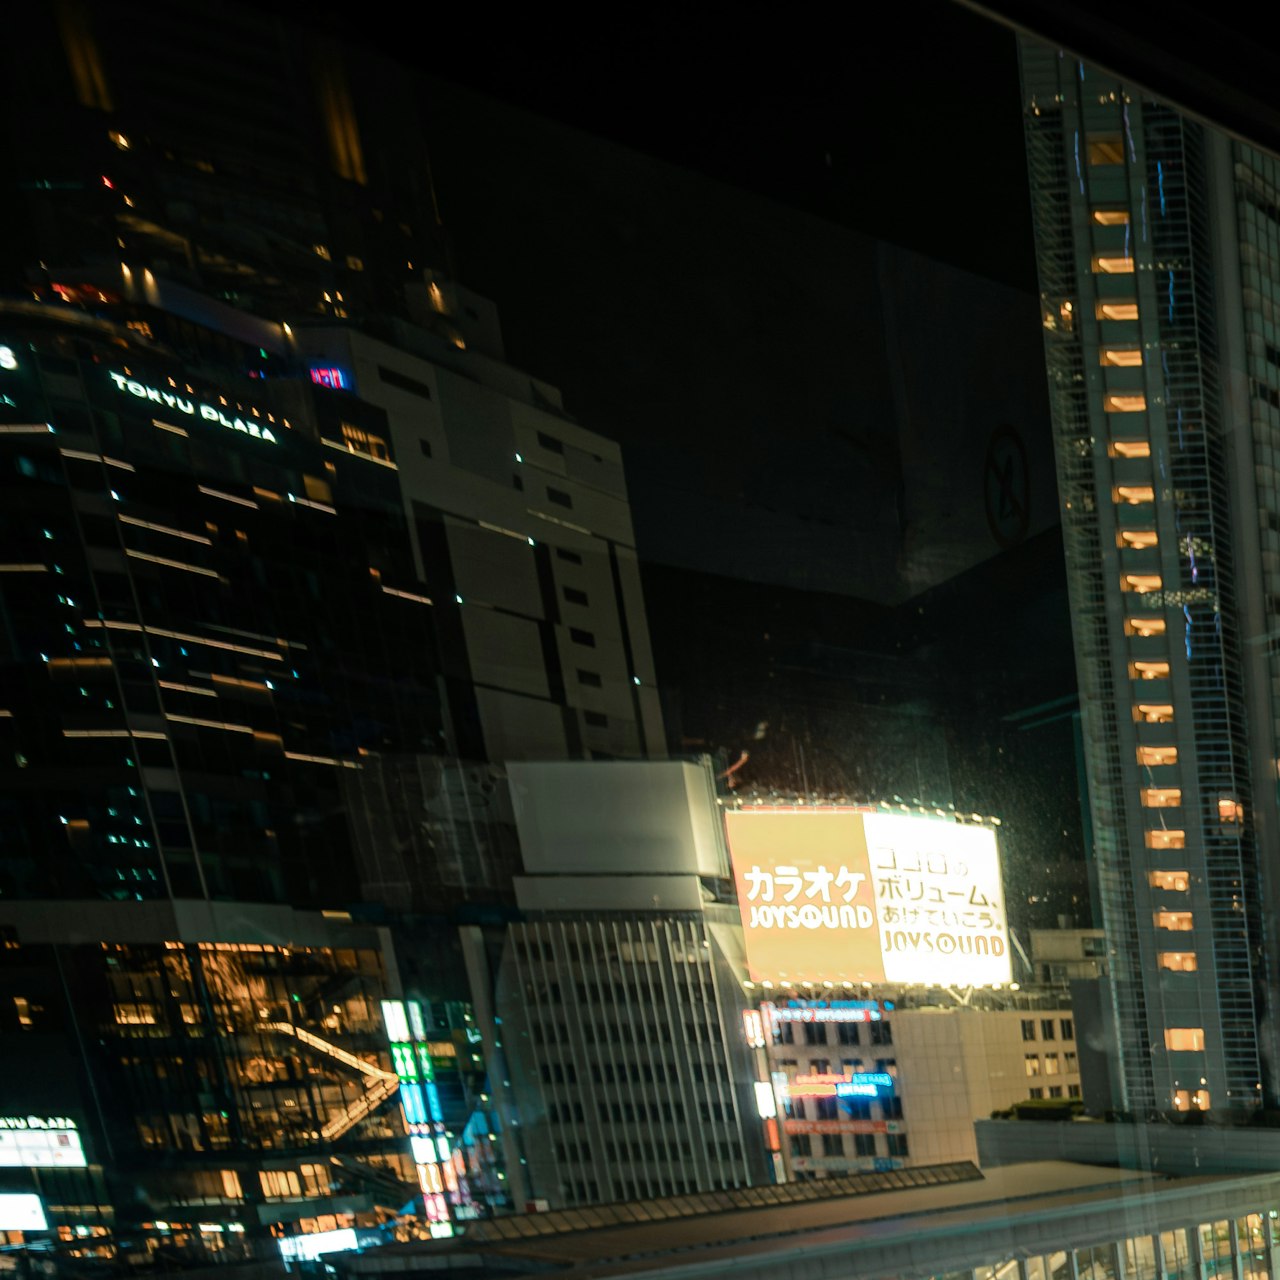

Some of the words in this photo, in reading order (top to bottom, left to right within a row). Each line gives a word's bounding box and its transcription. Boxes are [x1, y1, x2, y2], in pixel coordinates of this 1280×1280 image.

[109, 369, 195, 416] TOKYU
[200, 404, 278, 444] PLAZA
[743, 865, 866, 902] カラオケ
[878, 874, 998, 909] ボリューム、
[750, 904, 873, 929] JOYSOUND
[884, 930, 1005, 957] JOYSOUND
